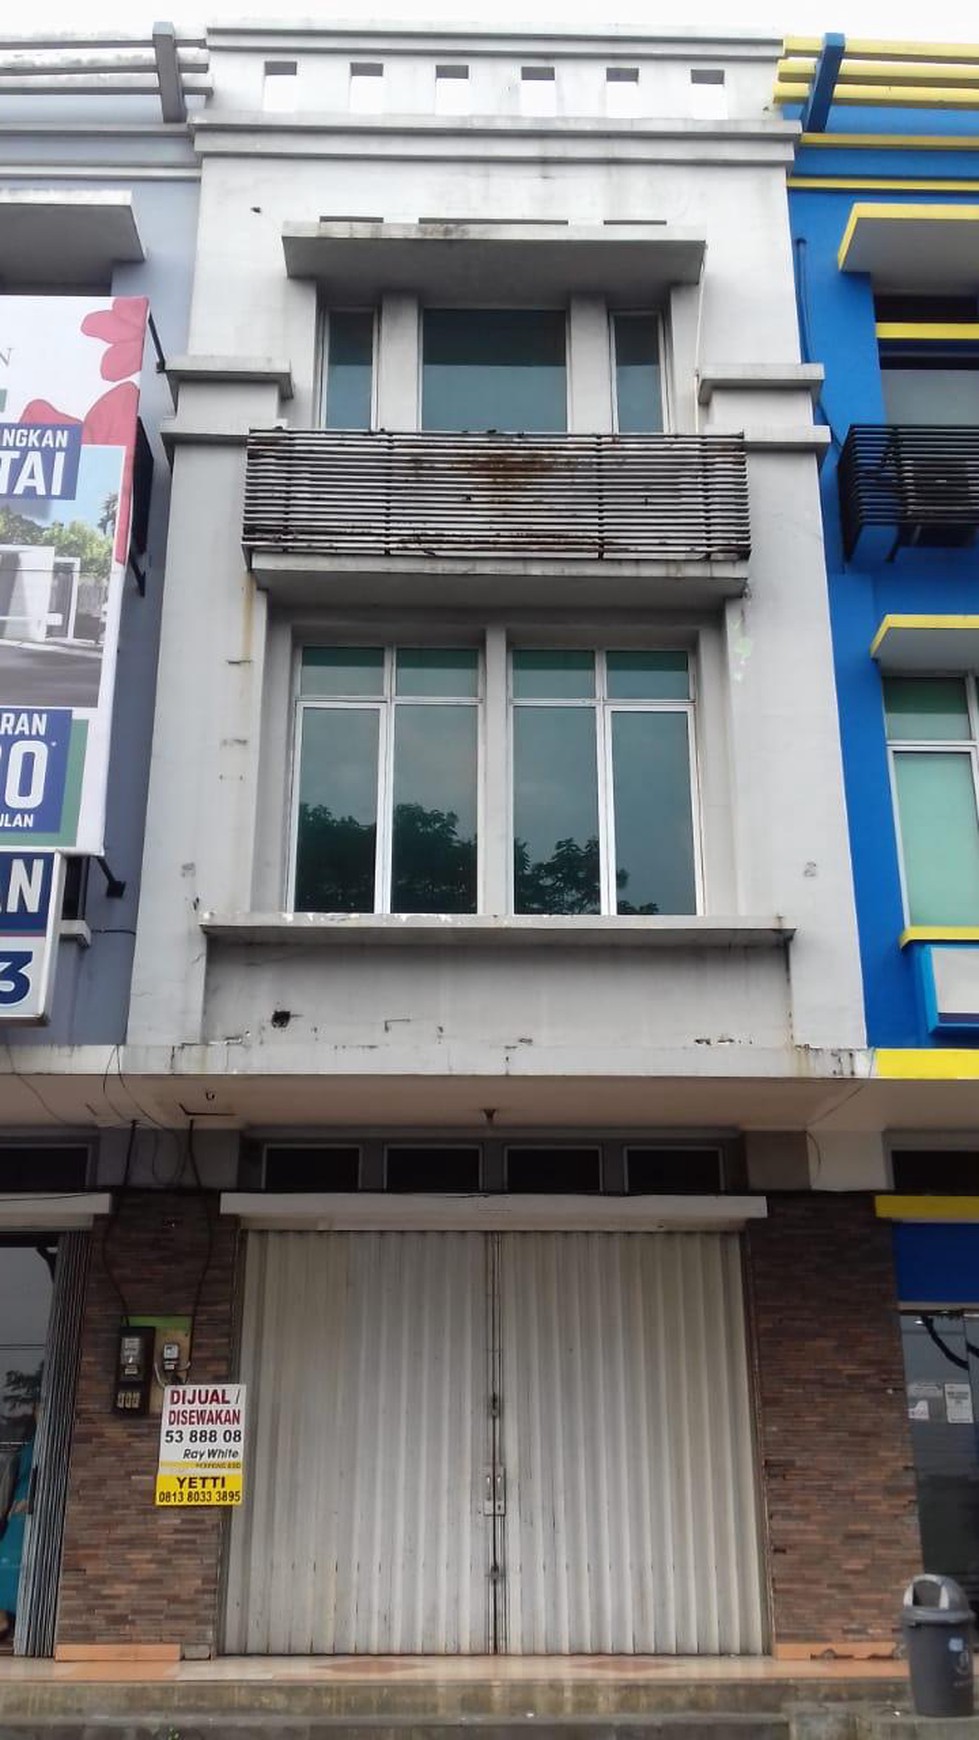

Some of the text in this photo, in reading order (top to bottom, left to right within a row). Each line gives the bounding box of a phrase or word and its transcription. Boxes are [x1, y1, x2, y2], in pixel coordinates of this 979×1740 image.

[0, 859, 44, 913] N
[170, 1389, 230, 1405] DIJUAL
[168, 1409, 241, 1426] DISEWAKAN
[165, 1429, 242, 1443] 53 888 08
[183, 1448, 239, 1461] Ray White
[176, 1476, 226, 1489] YETTI
[158, 1490, 241, 1503] 0813 8033 3895
